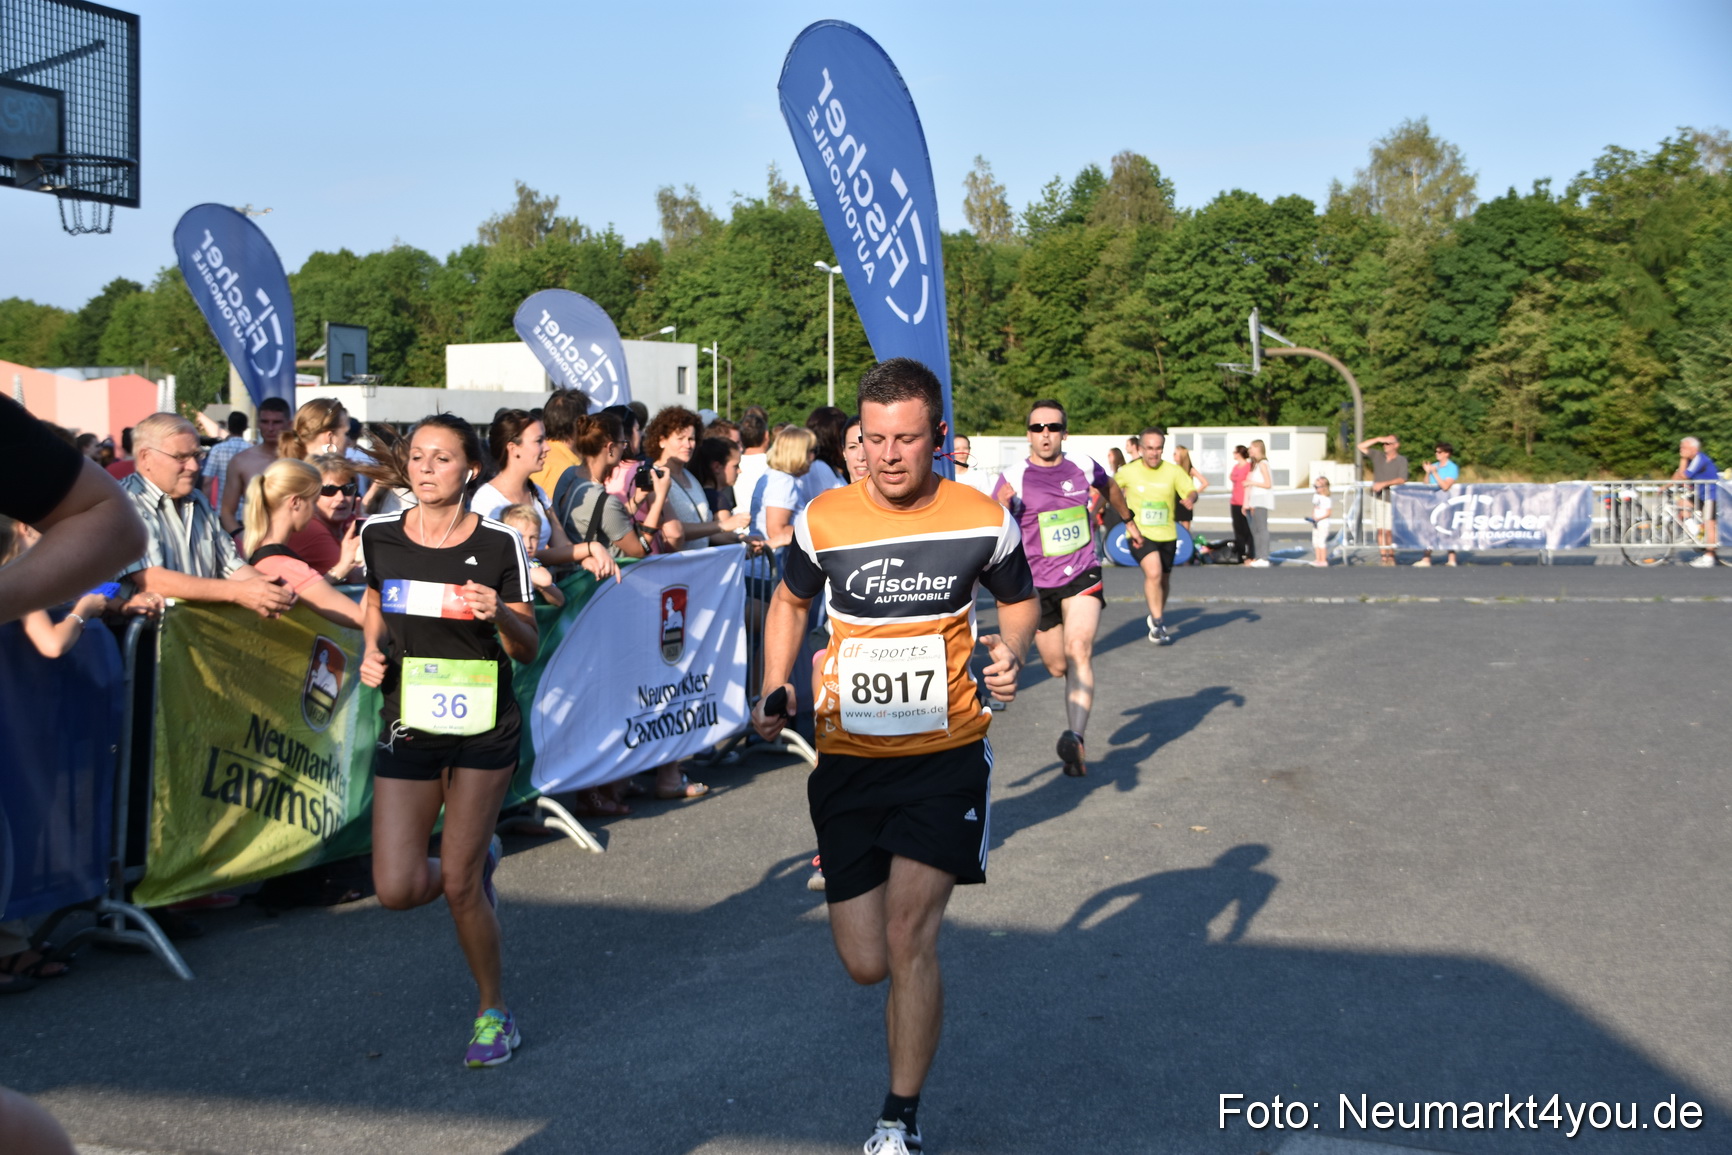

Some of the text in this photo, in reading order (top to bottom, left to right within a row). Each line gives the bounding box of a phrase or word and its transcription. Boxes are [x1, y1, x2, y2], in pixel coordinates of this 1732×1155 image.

[1145, 510, 1163, 520] 671
[1451, 509, 1550, 531] Fischer
[1052, 525, 1081, 542] 499
[1460, 530, 1542, 540] AUTOMOBILE
[865, 572, 958, 595] Fischer
[874, 592, 951, 604] AUTOMOBILE
[842, 643, 928, 661] df-sports
[851, 669, 935, 705] 8917
[431, 692, 468, 719] 36
[845, 704, 944, 719] www.df-sports.de
